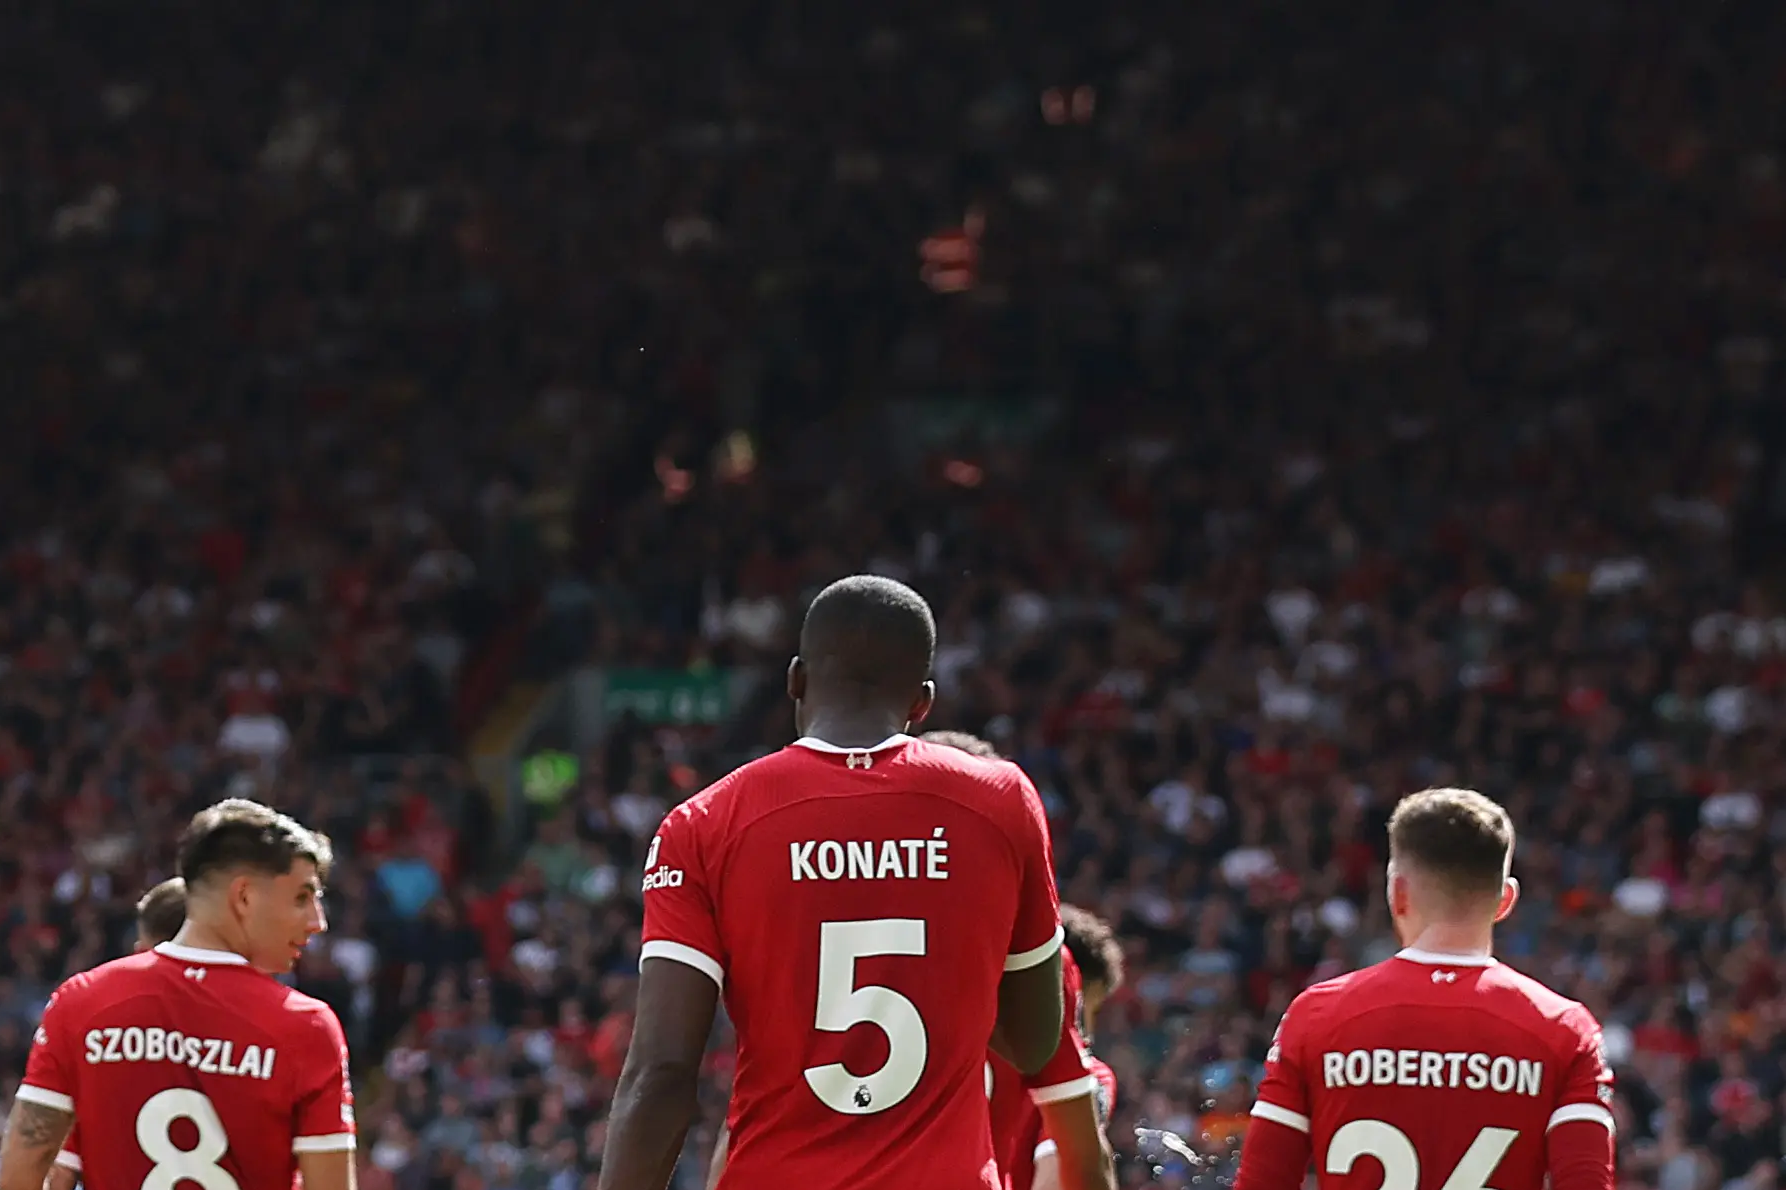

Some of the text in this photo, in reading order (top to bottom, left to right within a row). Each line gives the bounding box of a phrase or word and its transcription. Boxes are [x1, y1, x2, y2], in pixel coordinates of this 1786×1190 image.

[790, 827, 949, 881] KONATÉ
[804, 919, 927, 1114] 5
[85, 1026, 276, 1081] SZOBOSZLAI
[1323, 1048, 1543, 1097] ROBERTSON
